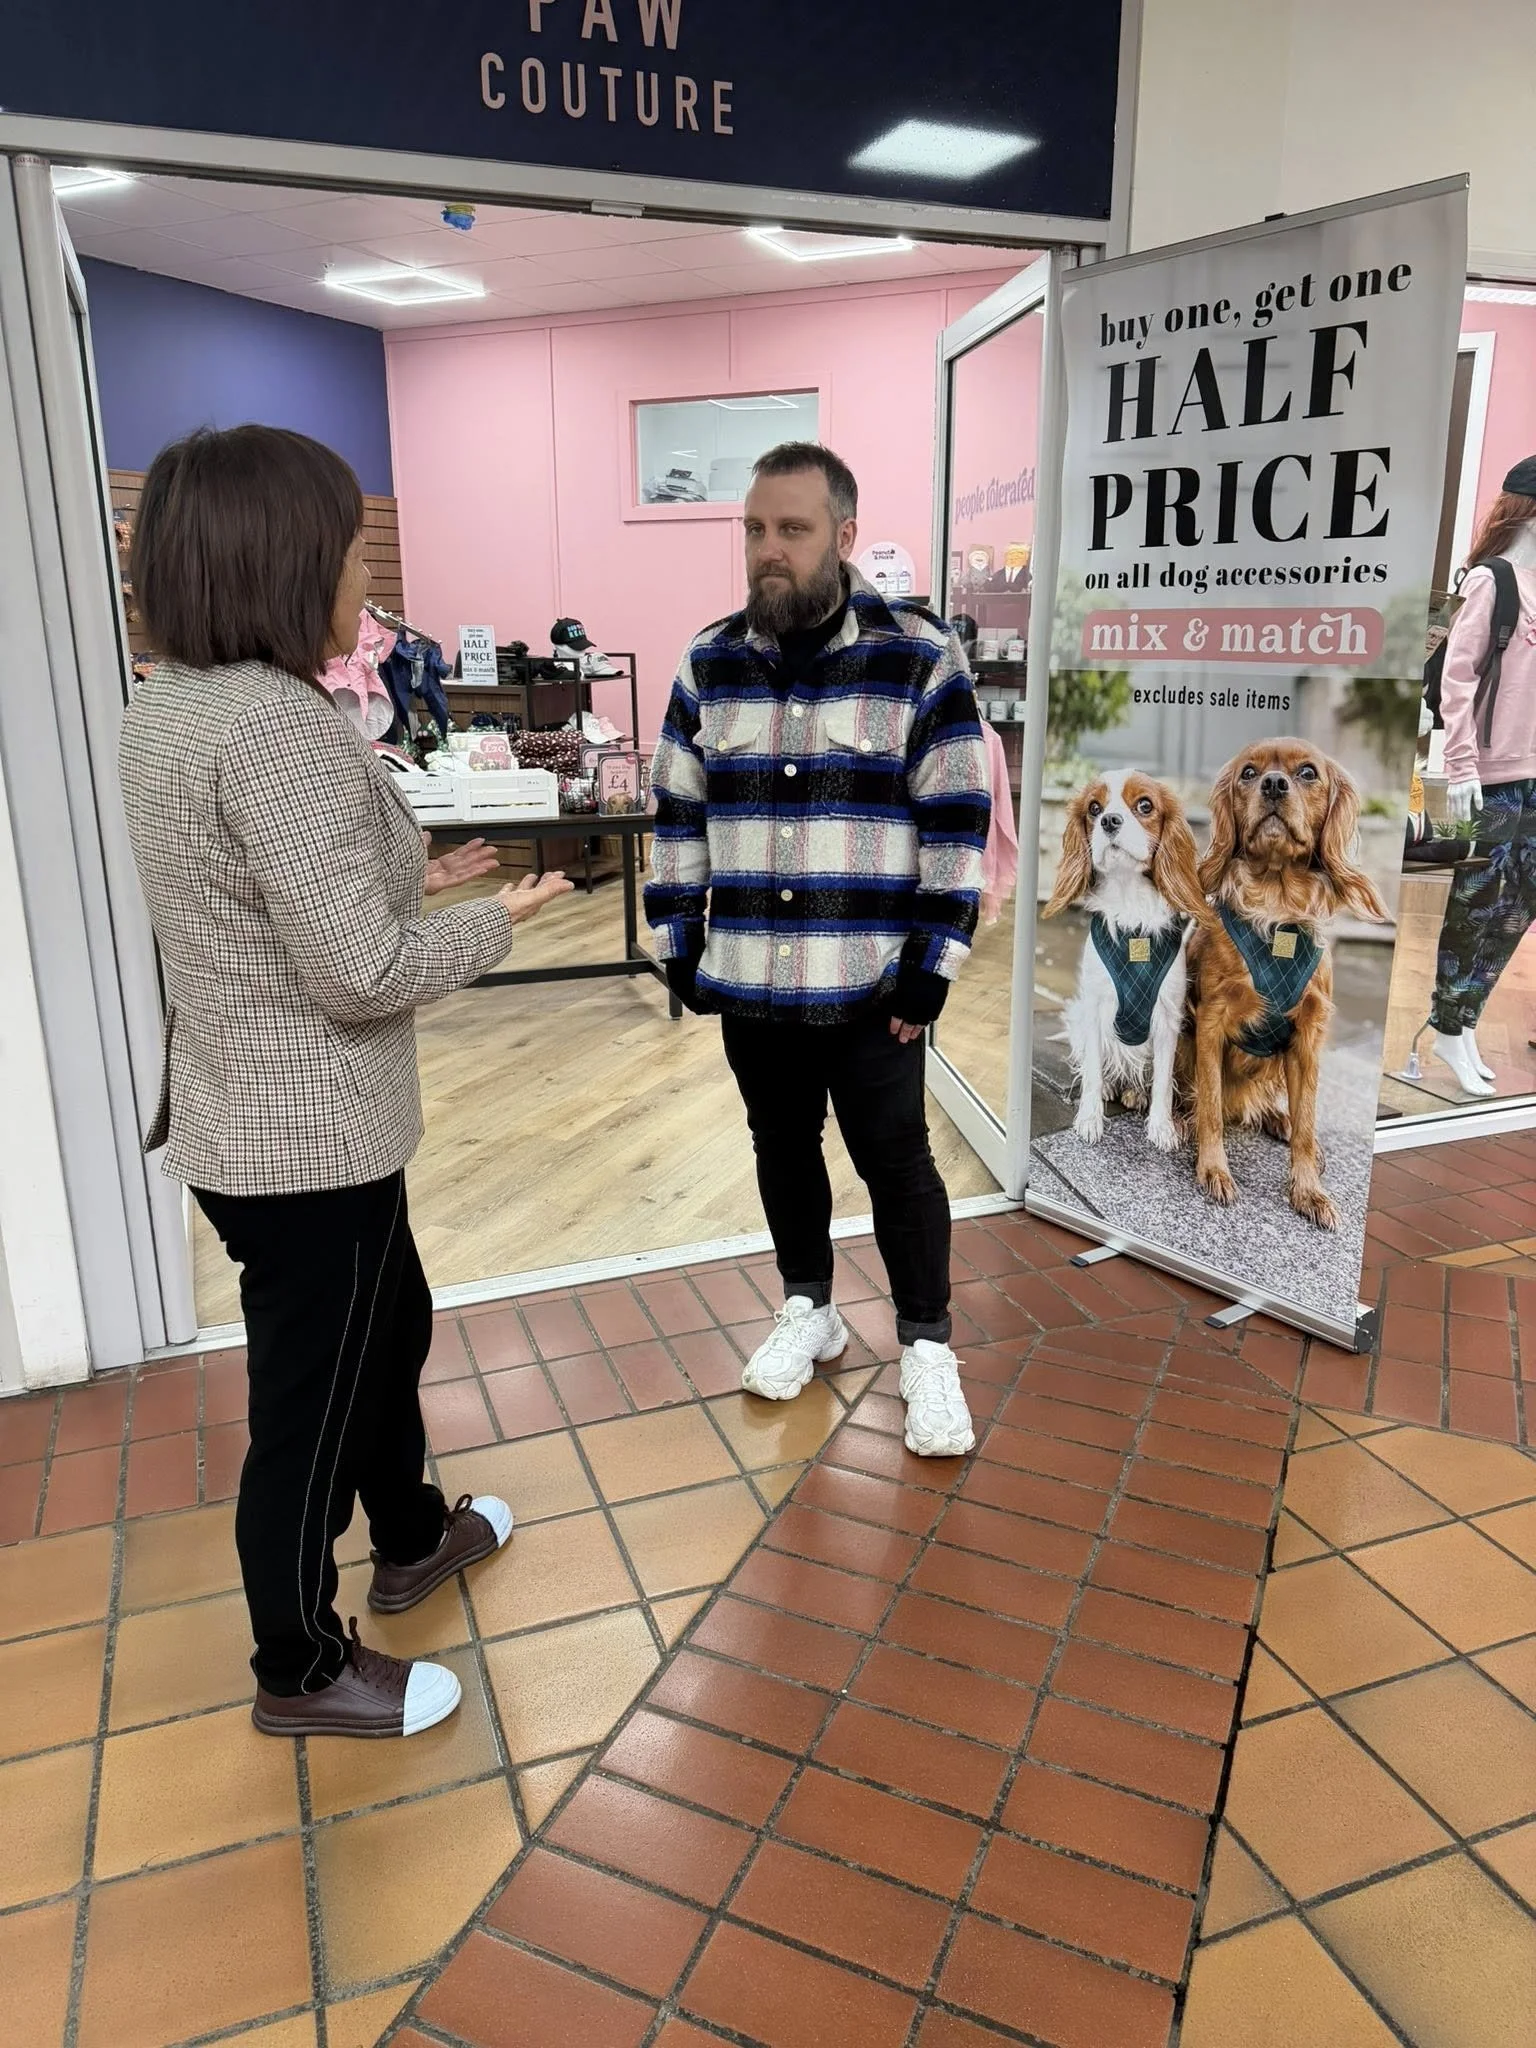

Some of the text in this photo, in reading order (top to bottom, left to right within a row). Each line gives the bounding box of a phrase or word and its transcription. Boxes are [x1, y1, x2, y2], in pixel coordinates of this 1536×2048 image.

[480, 52, 734, 135] COUTURE
[1100, 263, 1412, 350] buy one, get one
[1102, 320, 1368, 444] HALF
[954, 466, 1036, 525] people tolerated
[1087, 446, 1391, 551] PRICE
[1085, 556, 1388, 594] on all dog accessories
[463, 639, 490, 649] HALF
[1090, 612, 1368, 655] mix & match
[464, 651, 493, 664] PRICE
[1134, 685, 1291, 711] excludes sale items
[608, 774, 628, 792] £4
